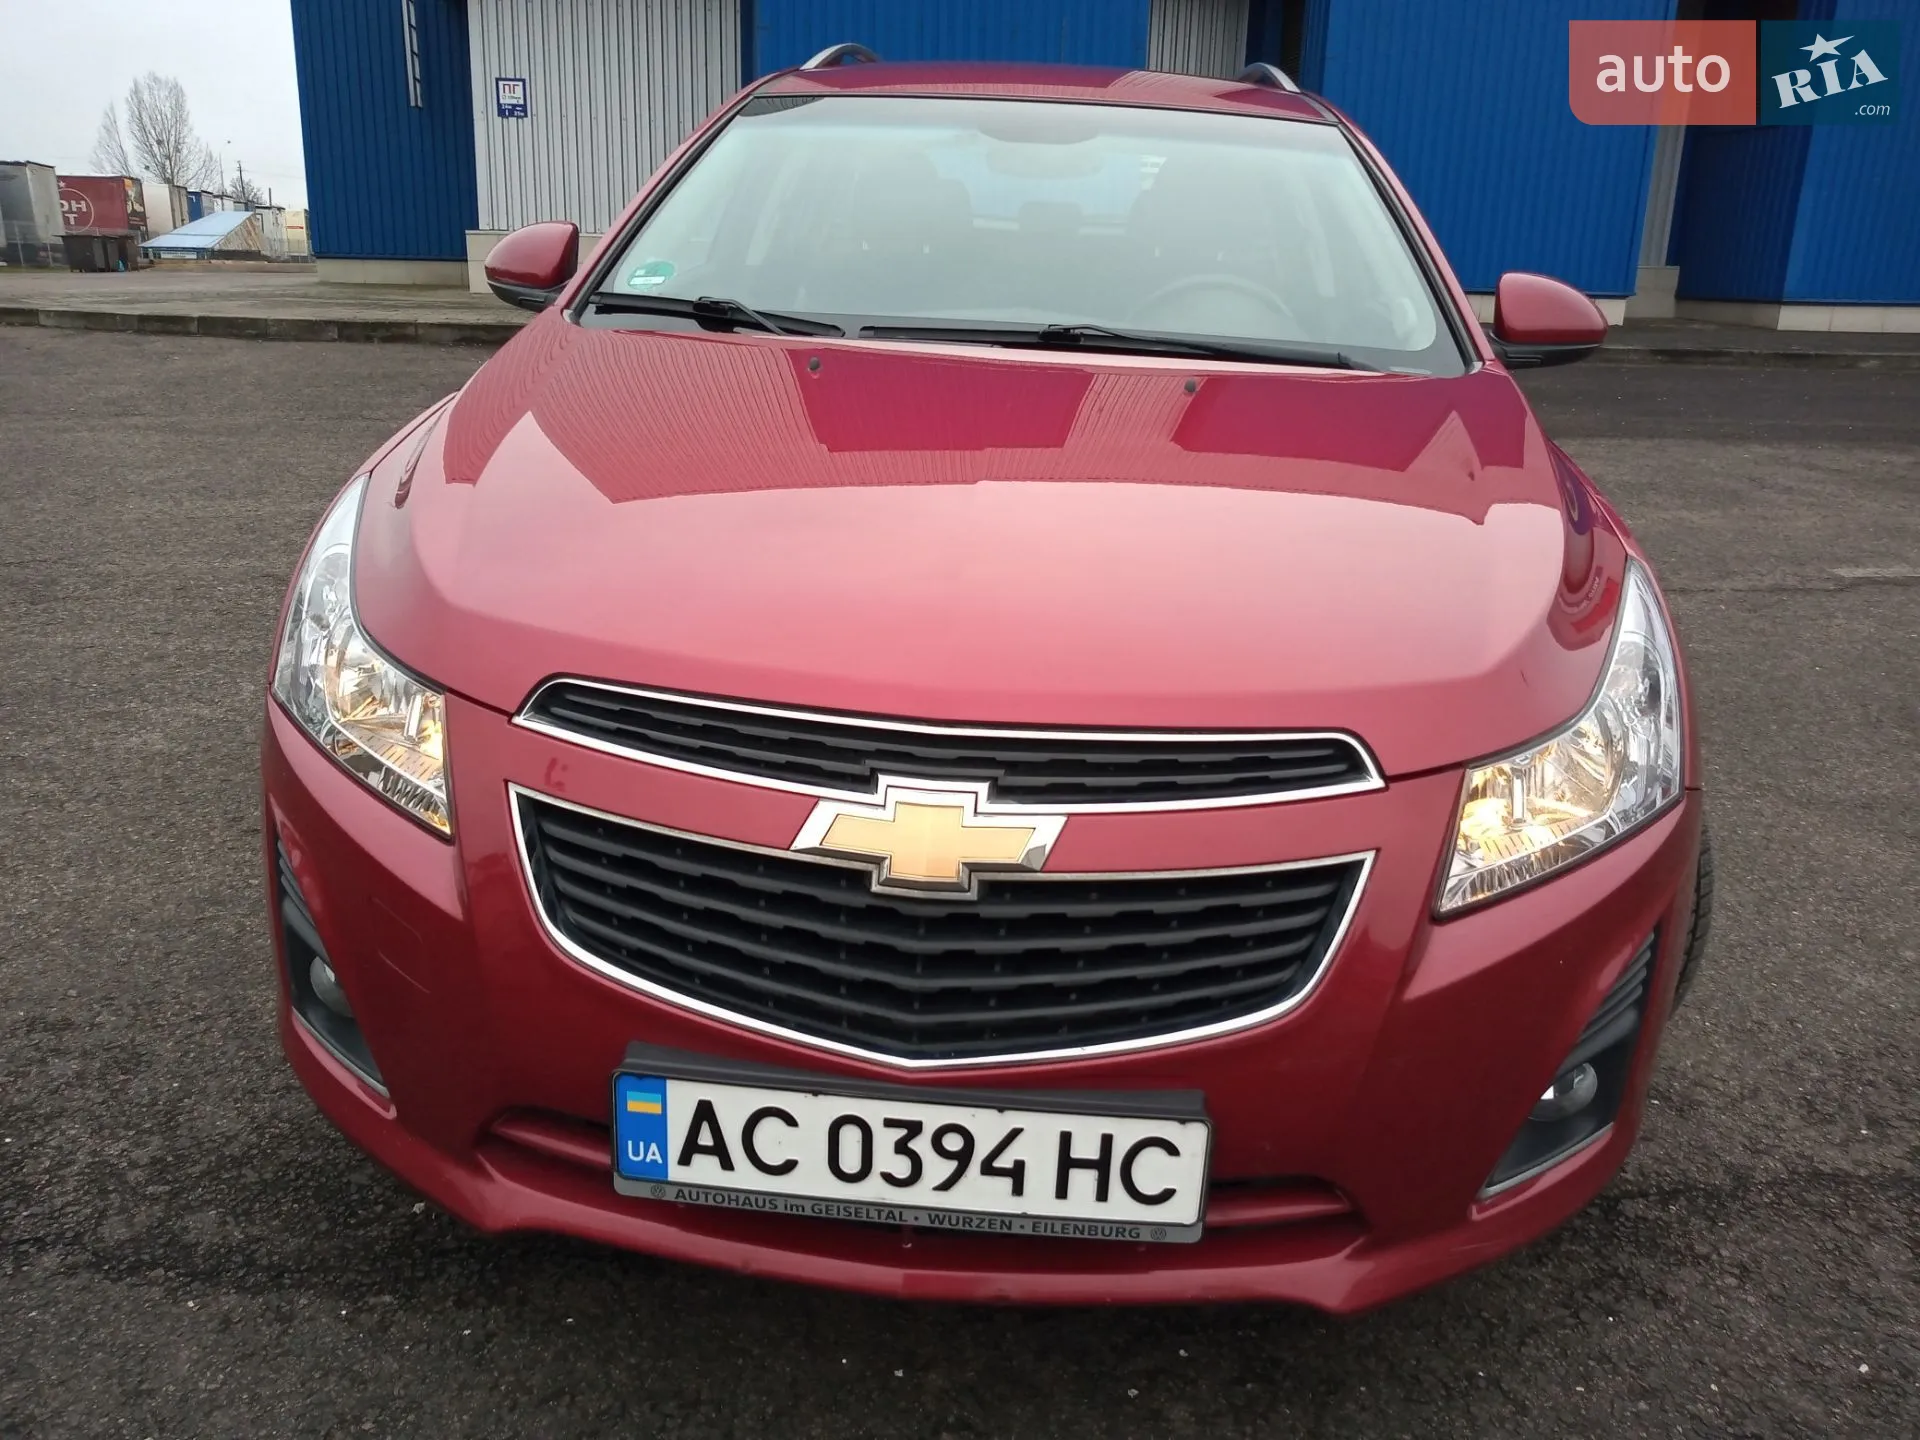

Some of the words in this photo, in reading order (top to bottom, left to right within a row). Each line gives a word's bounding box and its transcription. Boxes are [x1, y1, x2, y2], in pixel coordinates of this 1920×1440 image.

[627, 1140, 663, 1164] UA
[677, 1098, 799, 1176] AC
[827, 1114, 1025, 1197] 0394
[1055, 1130, 1181, 1206] HC
[674, 1188, 779, 1211] AUTOHAUS
[783, 1200, 805, 1213] im
[811, 1204, 908, 1223] GEISELTAL
[927, 1212, 1012, 1231] WURZEN
[1031, 1221, 1141, 1239] EILENBURG
